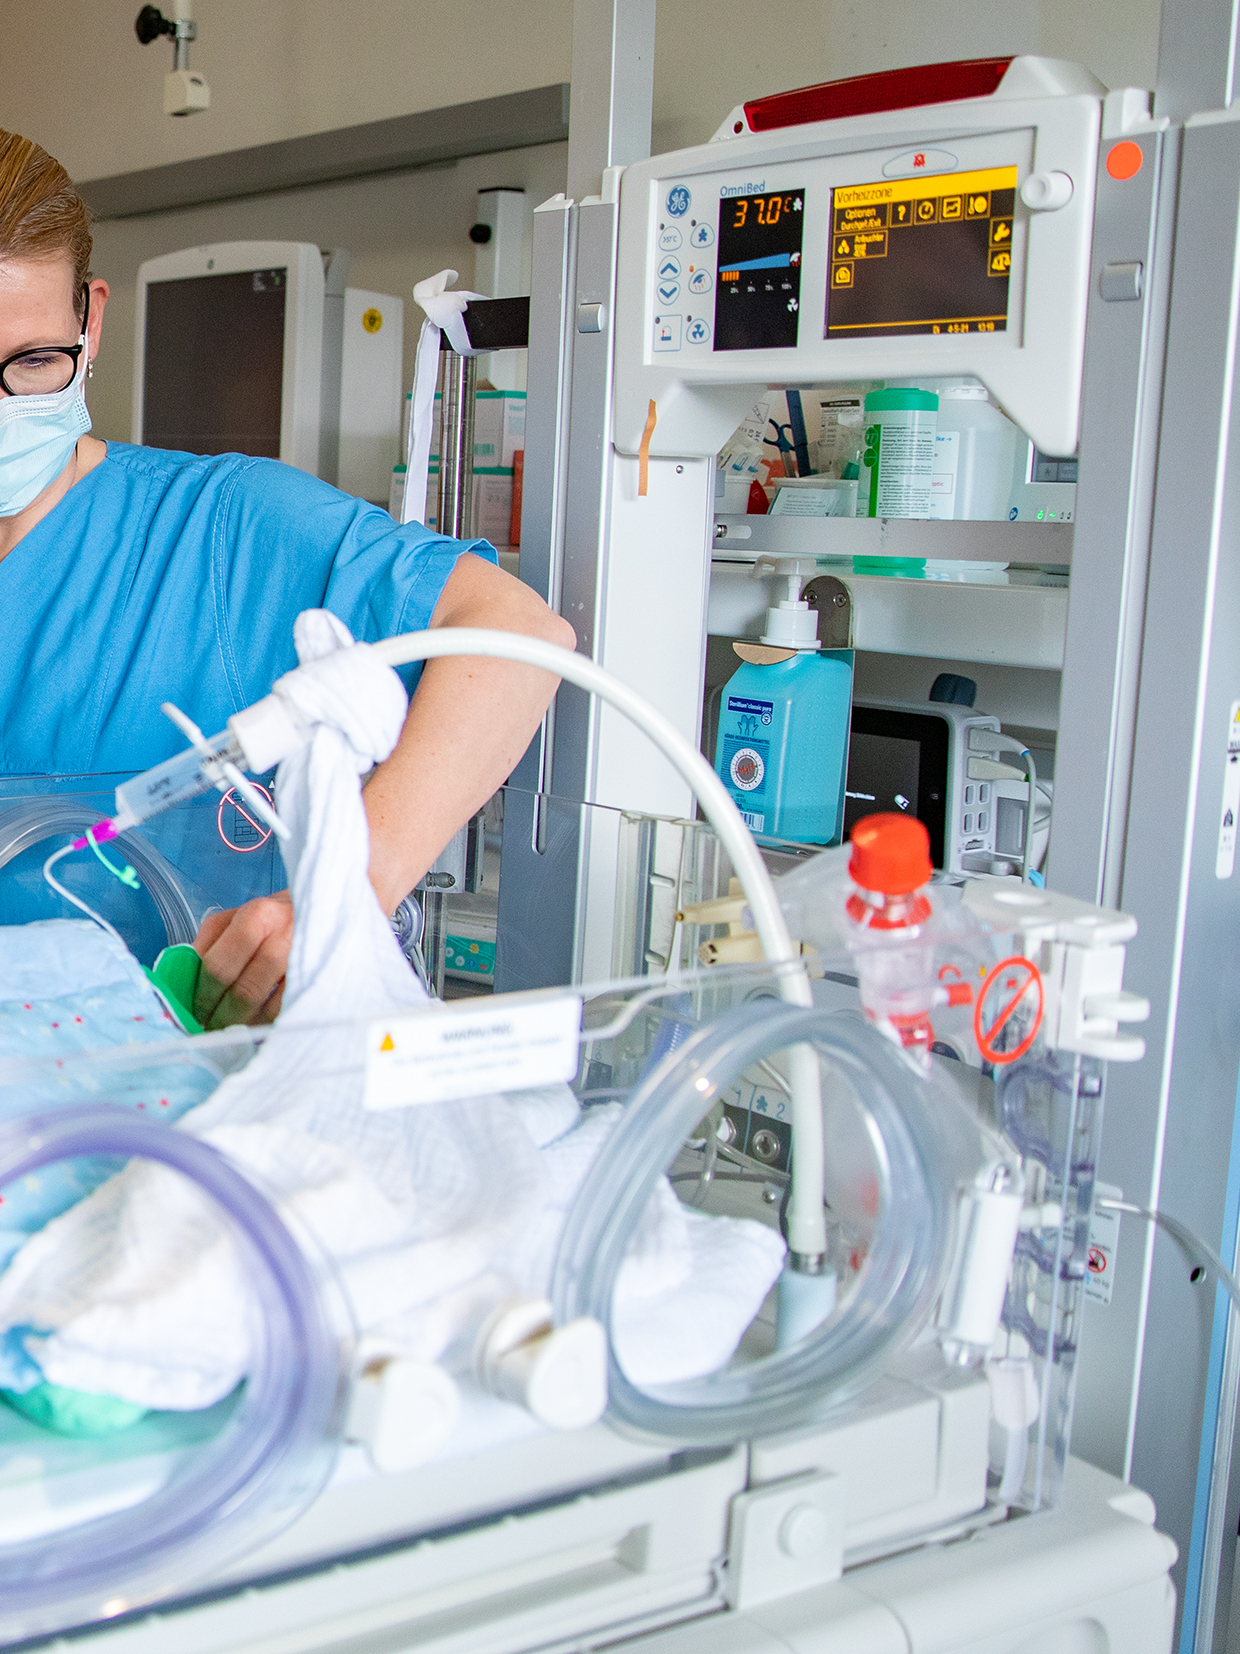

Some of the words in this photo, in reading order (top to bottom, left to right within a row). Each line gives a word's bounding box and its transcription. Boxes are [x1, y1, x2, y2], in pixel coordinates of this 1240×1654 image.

[720, 181, 765, 197] OmniBed
[837, 188, 893, 203] Vorheizzone
[733, 196, 782, 228] 37.0
[776, 1102, 786, 1121] 2
